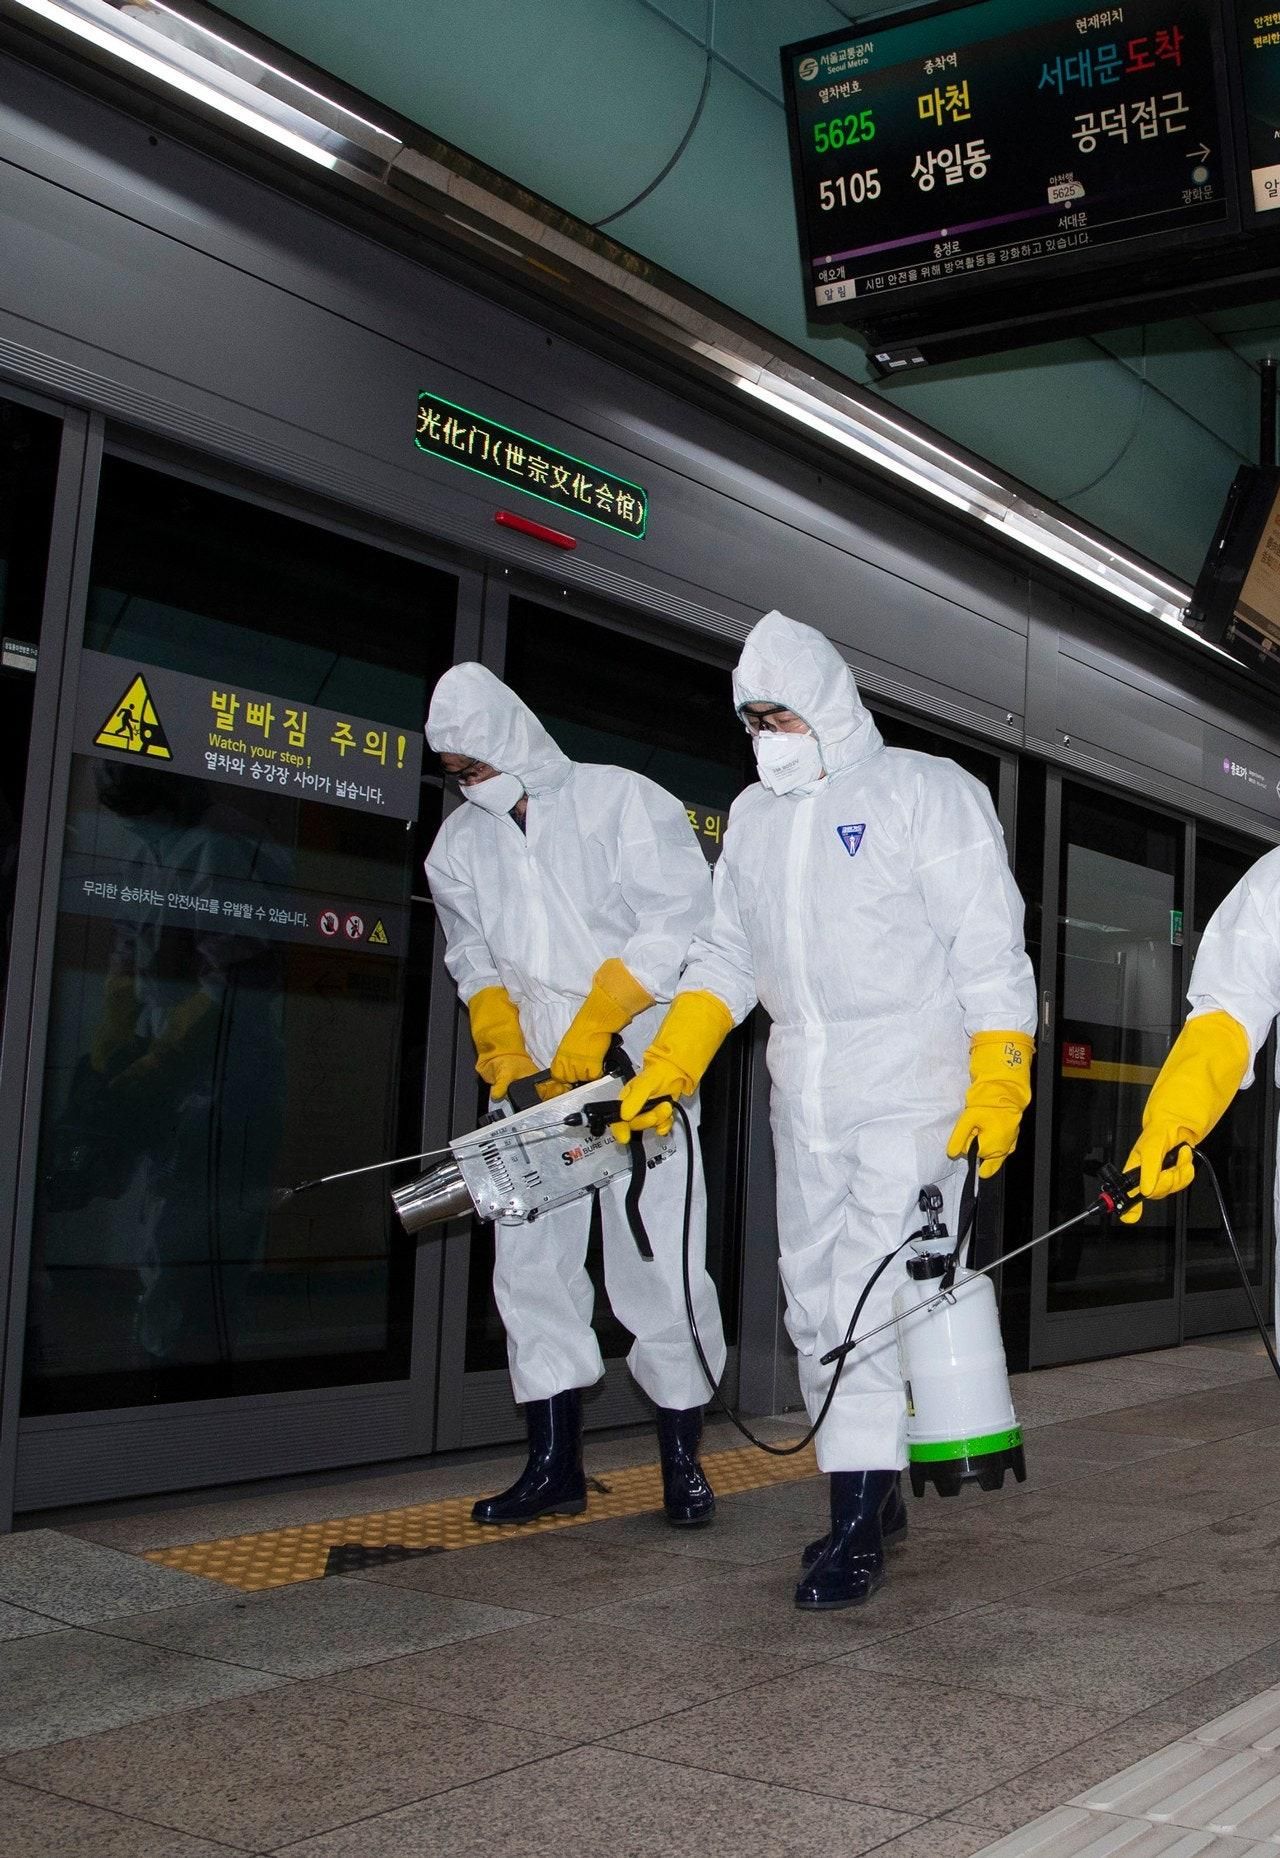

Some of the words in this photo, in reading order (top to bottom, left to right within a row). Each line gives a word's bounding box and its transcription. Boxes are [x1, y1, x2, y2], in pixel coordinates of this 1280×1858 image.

[1075, 8, 1124, 34] 현재위치
[1253, 31, 1280, 48] 편리한
[820, 41, 874, 66] 서울교통공사
[827, 63, 846, 75] Seoul
[847, 57, 869, 70] Metro
[923, 52, 958, 75] 종착역
[818, 80, 862, 104] 열차번호
[917, 80, 971, 126] 마천
[814, 110, 876, 153] 5625
[1072, 91, 1190, 153] 공덕접근
[911, 139, 991, 192] 상일동
[819, 168, 881, 211] 5105
[1053, 185, 1077, 200] 5625
[1182, 184, 1214, 204] 광화문
[1058, 212, 1088, 230] 서대문
[865, 277, 885, 290] 시민
[888, 269, 918, 286] 안전을
[921, 264, 941, 278] 위해
[944, 252, 996, 274] 방역활동을
[1000, 242, 1042, 262] 강화하고
[1045, 232, 1093, 251] 있습니다.
[934, 241, 961, 258] 충정로
[818, 265, 846, 283] 애오개
[209, 733, 247, 753] Watch
[251, 745, 277, 760] your
[204, 751, 245, 775] 열차와
[250, 762, 290, 785] 승강장
[294, 771, 332, 793] 사이가
[336, 780, 385, 804] 넓습니다.
[82, 881, 118, 899] 무리한
[121, 886, 165, 906] 승하차는
[168, 893, 220, 914] 안전사고를
[222, 901, 253, 919] 유발할
[255, 906, 266, 920] 수
[269, 908, 309, 927] 있습니다.
